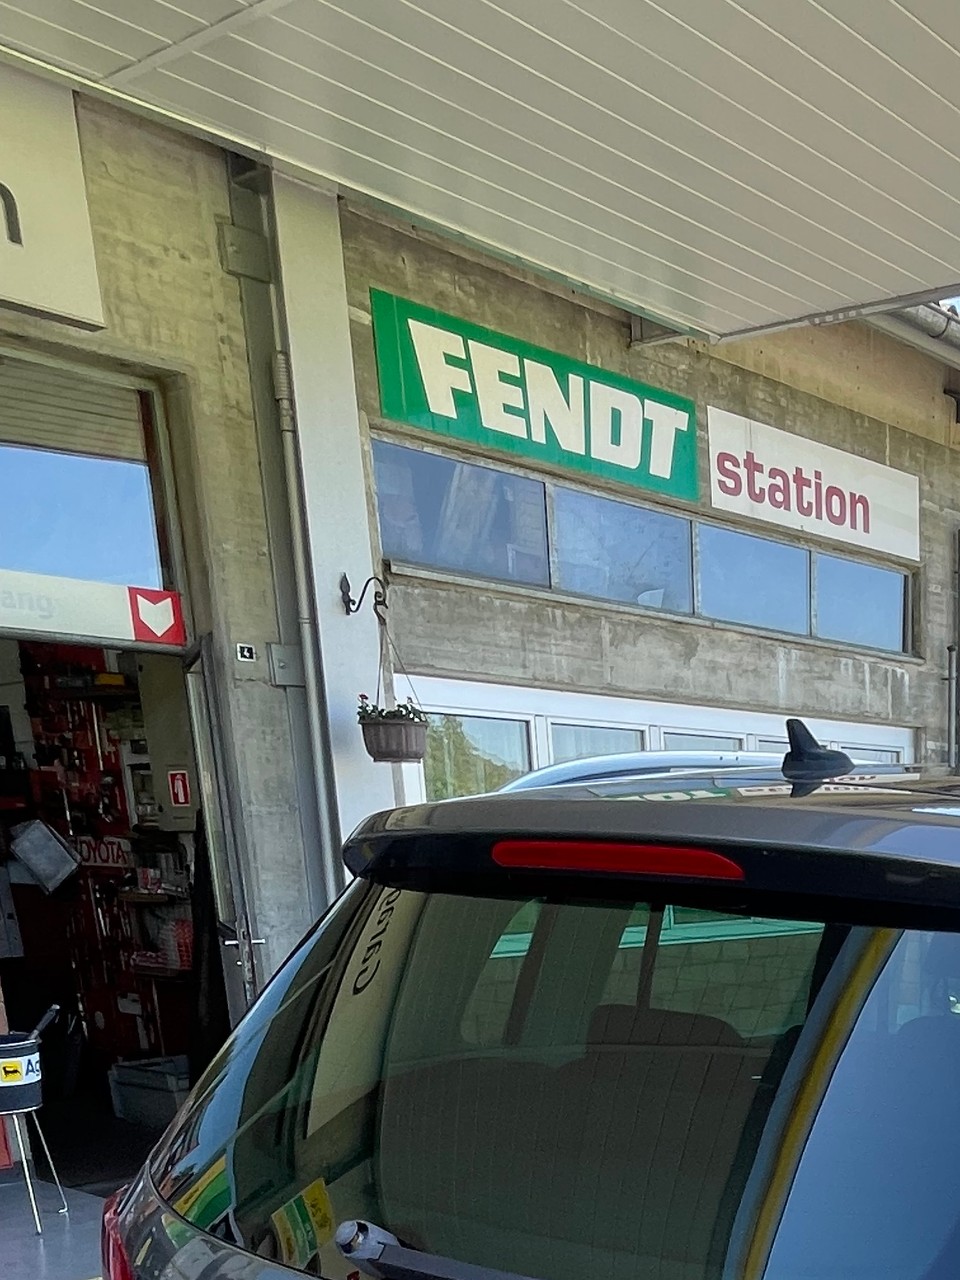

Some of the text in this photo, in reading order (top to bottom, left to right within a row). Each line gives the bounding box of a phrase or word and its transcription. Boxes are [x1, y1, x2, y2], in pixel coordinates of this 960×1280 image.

[407, 318, 690, 480] FENDT
[716, 450, 871, 535] station
[79, 840, 128, 865] OYOTA
